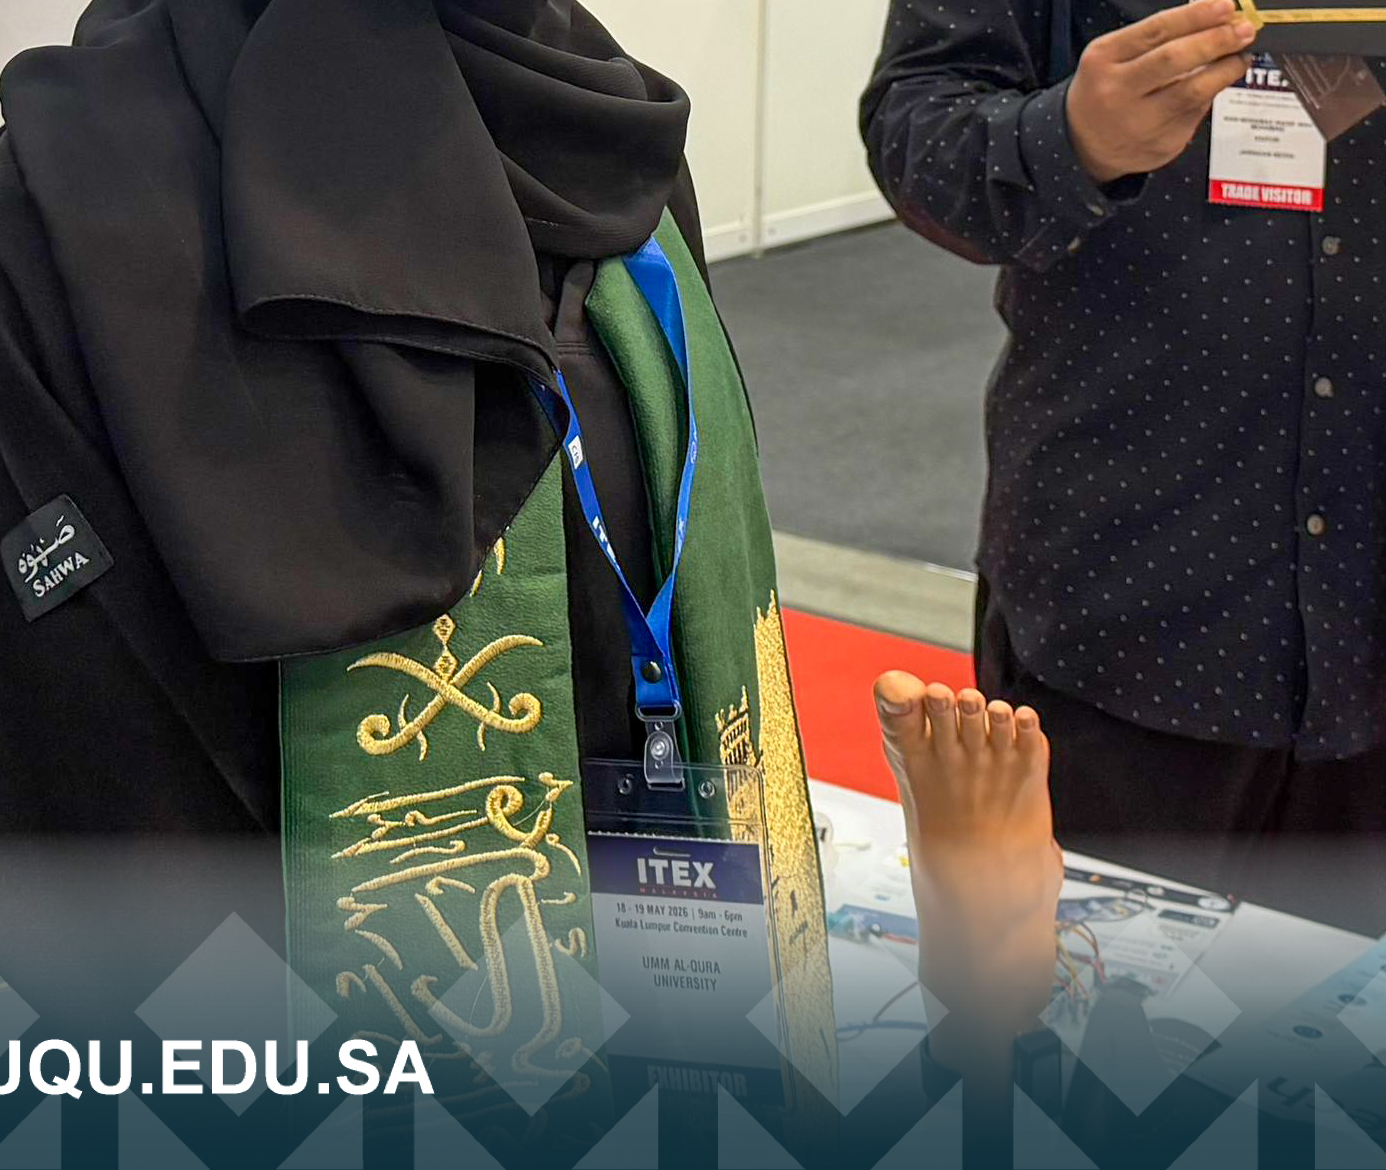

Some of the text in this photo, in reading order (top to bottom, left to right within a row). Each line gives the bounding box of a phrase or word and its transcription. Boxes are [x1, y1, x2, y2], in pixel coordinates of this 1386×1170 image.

[1221, 182, 1313, 206] TRADE VISITOR
[32, 552, 90, 597] SAHWA
[637, 857, 717, 890] ITEX
[616, 902, 626, 913] 18
[635, 903, 645, 914] 19
[647, 904, 666, 916] MAY
[668, 905, 689, 918] 2026
[698, 908, 717, 921] 9am
[724, 909, 743, 924] 6pm
[615, 916, 748, 938] Kuala Lumpur Convention Centre
[642, 956, 721, 975] UMM AL-QURA
[654, 974, 717, 991] UNIVERSITY
[646, 1064, 748, 1098] EXHIBITOR
